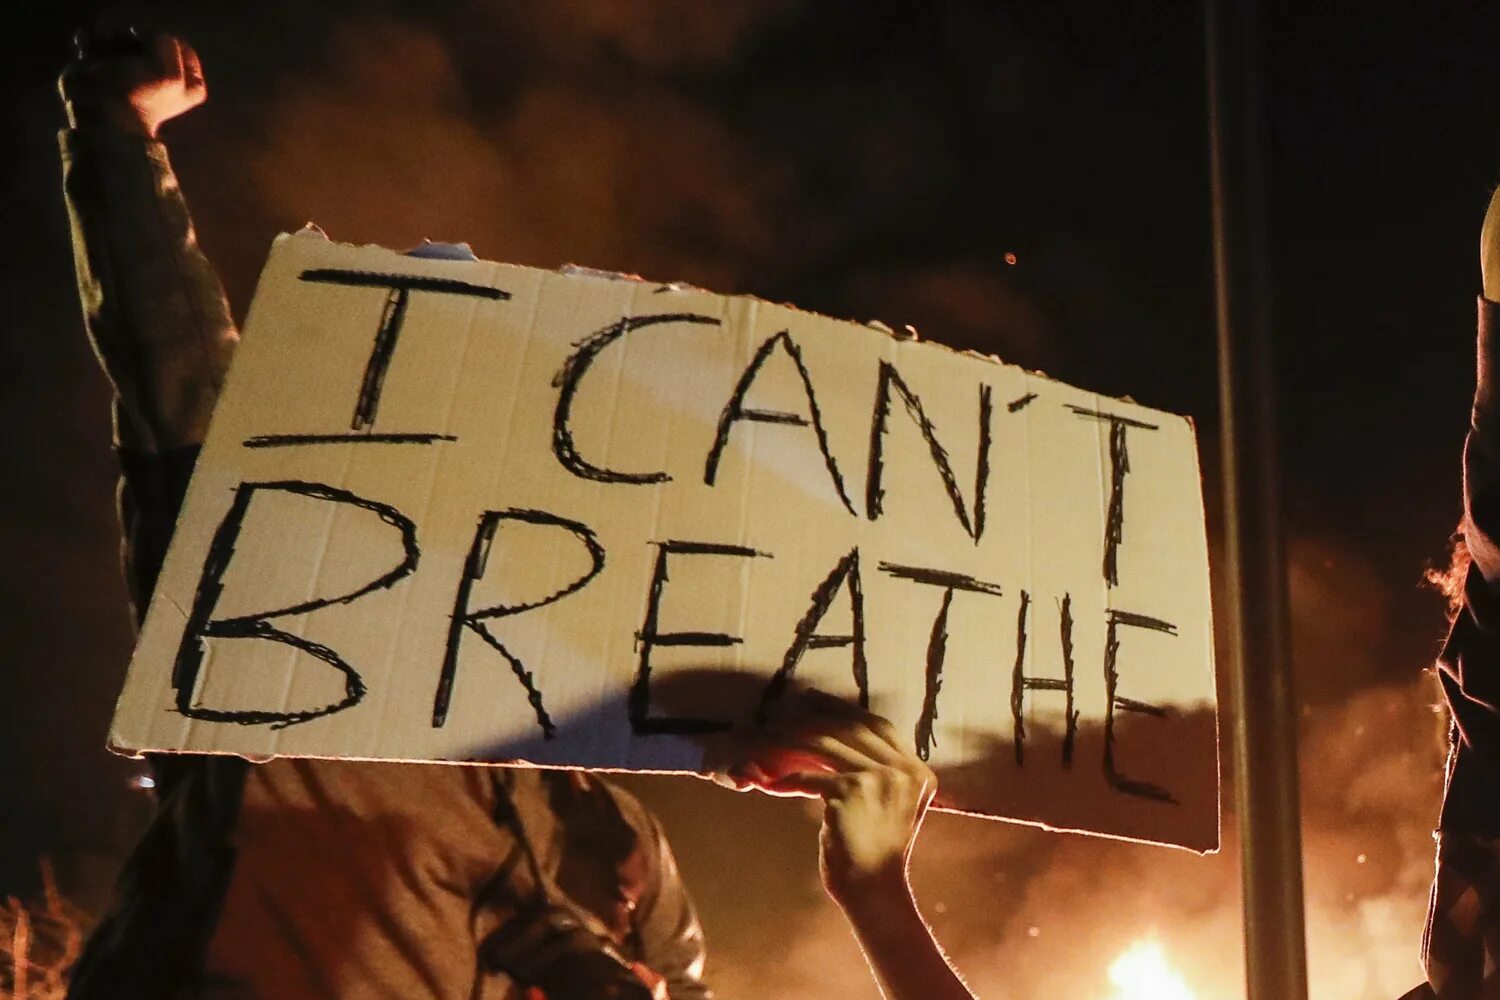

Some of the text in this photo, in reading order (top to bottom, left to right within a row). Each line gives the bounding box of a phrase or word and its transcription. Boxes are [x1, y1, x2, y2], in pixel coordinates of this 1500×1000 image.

[243, 268, 1158, 588] I CAN'T
[167, 480, 1179, 804] BREATHE
